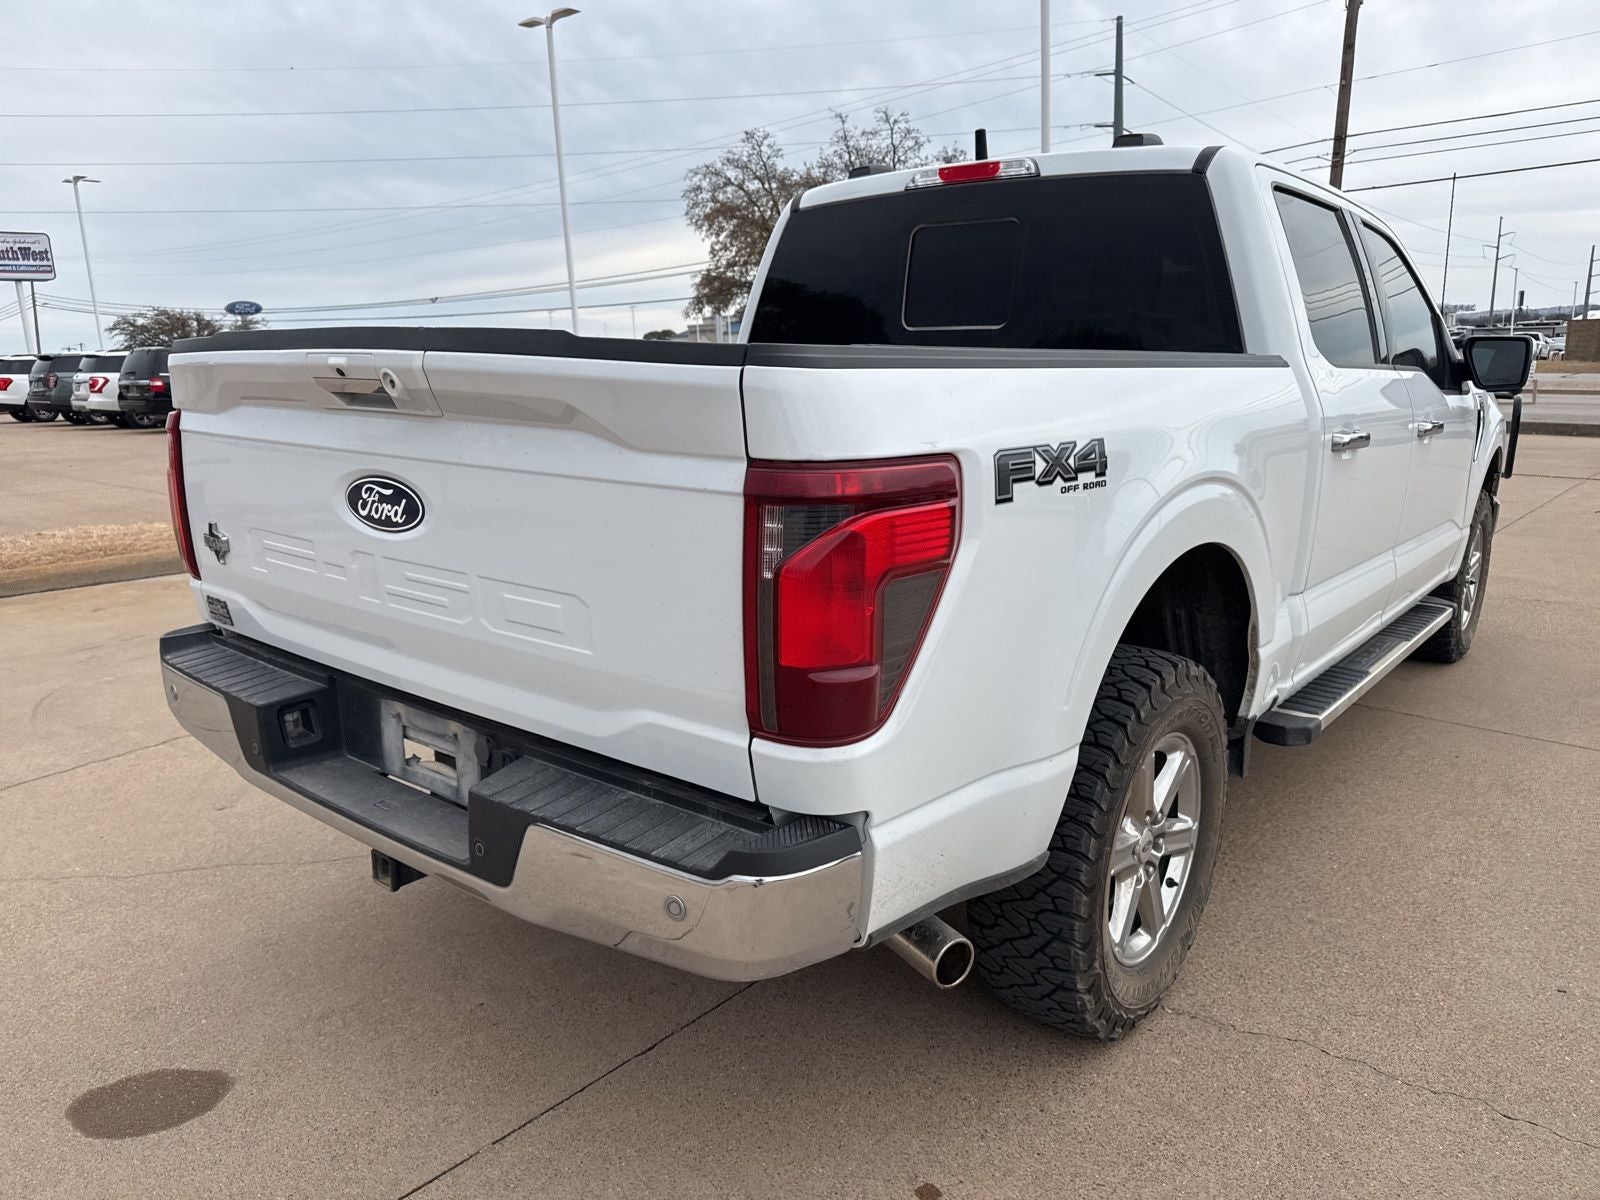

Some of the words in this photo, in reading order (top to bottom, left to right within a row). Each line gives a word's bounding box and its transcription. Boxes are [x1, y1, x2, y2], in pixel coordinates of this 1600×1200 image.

[993, 437, 1107, 506] FX4
[1060, 484, 1080, 495] OFF
[1082, 479, 1107, 491] ROAD
[357, 483, 407, 524] Ford
